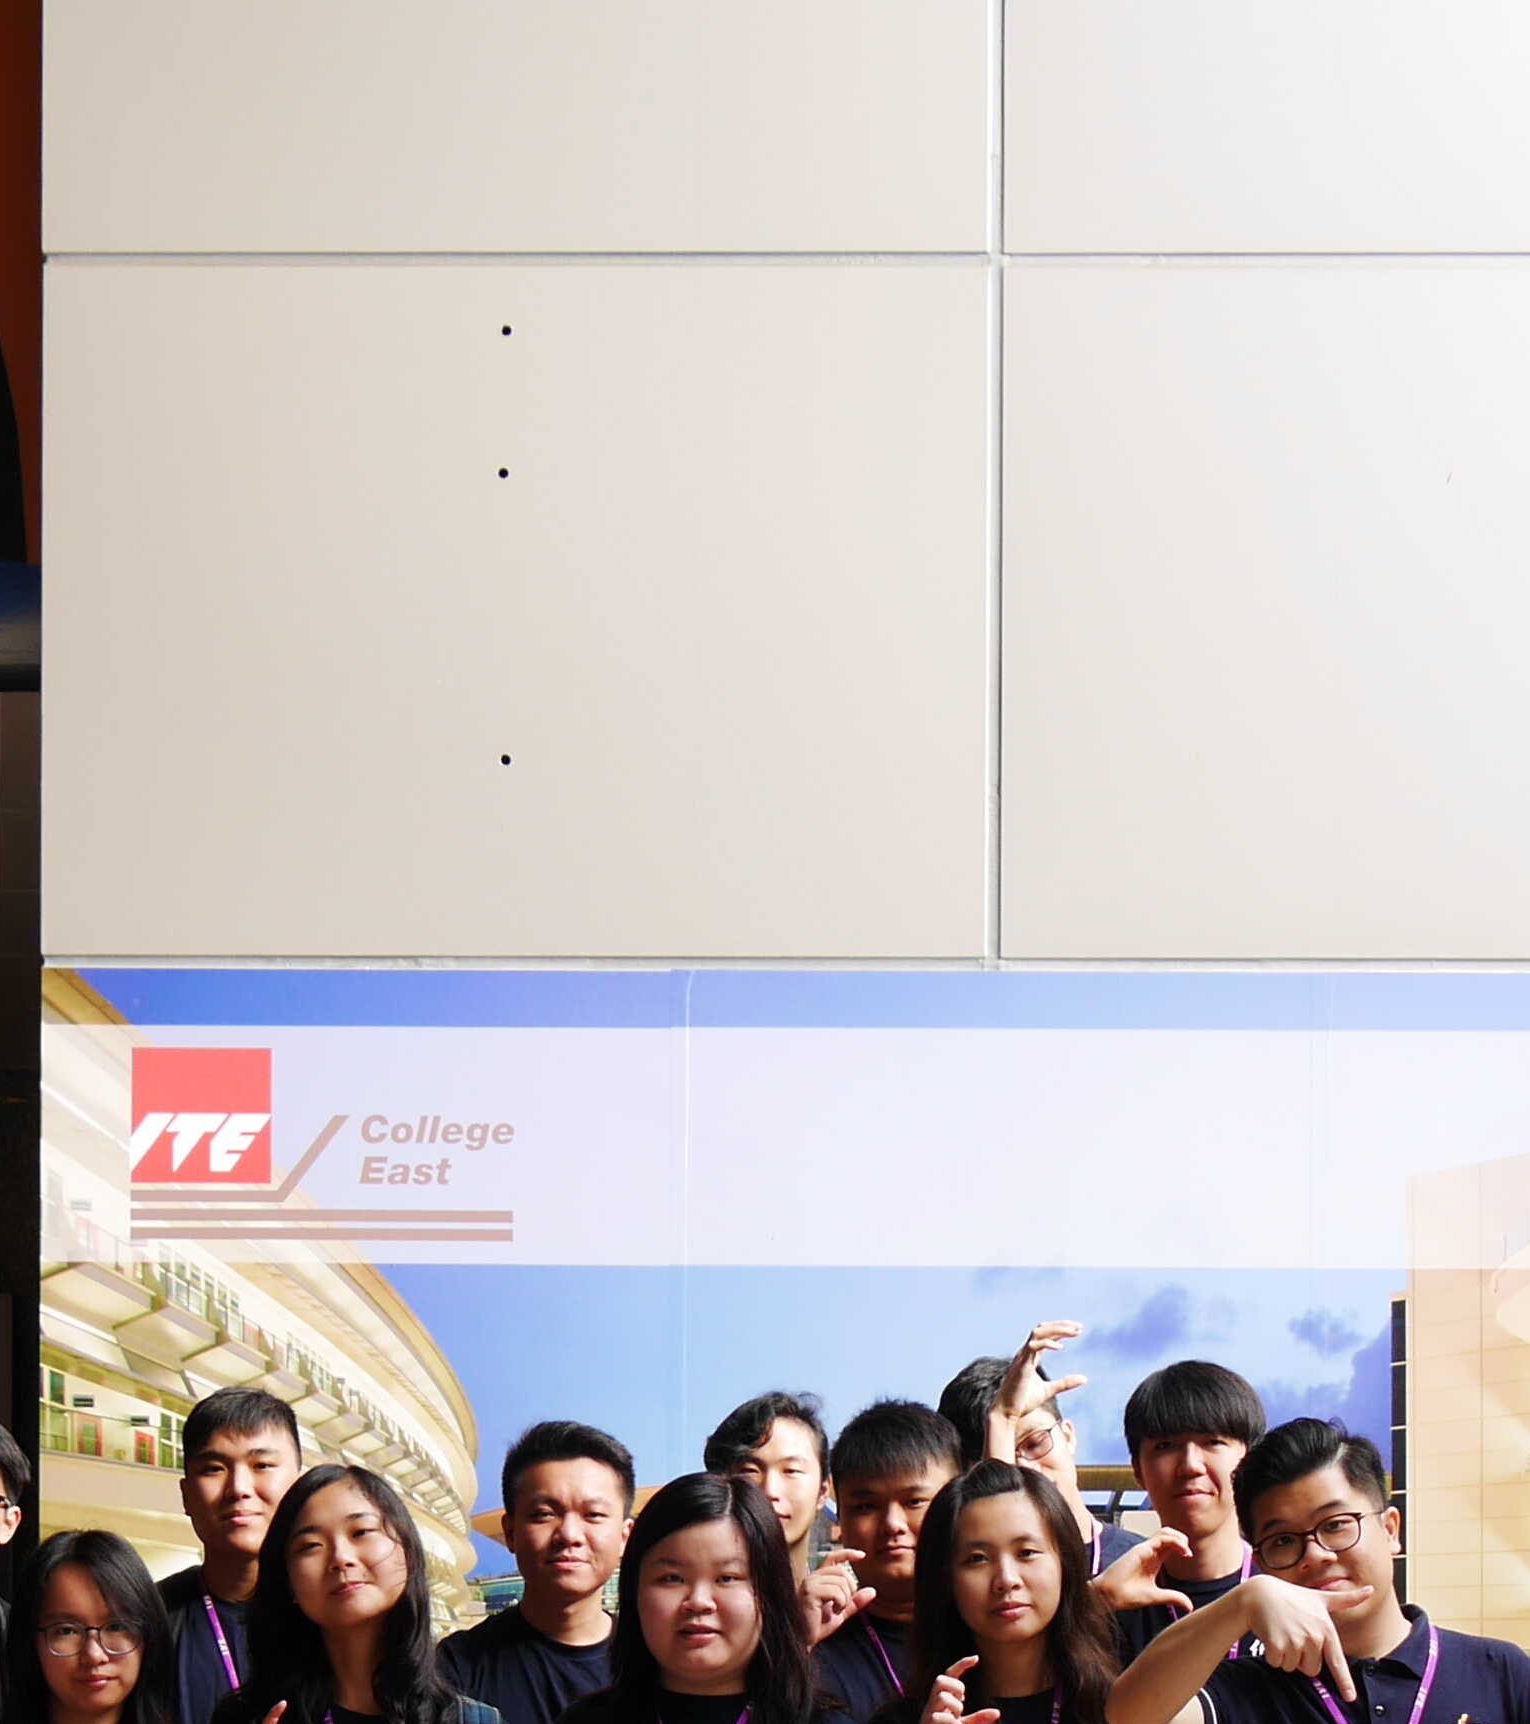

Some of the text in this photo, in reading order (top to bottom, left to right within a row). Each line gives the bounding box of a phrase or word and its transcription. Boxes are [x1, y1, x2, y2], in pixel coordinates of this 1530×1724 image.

[131, 1112, 271, 1173] ITE
[360, 1114, 515, 1151] College
[359, 1156, 452, 1186] East
